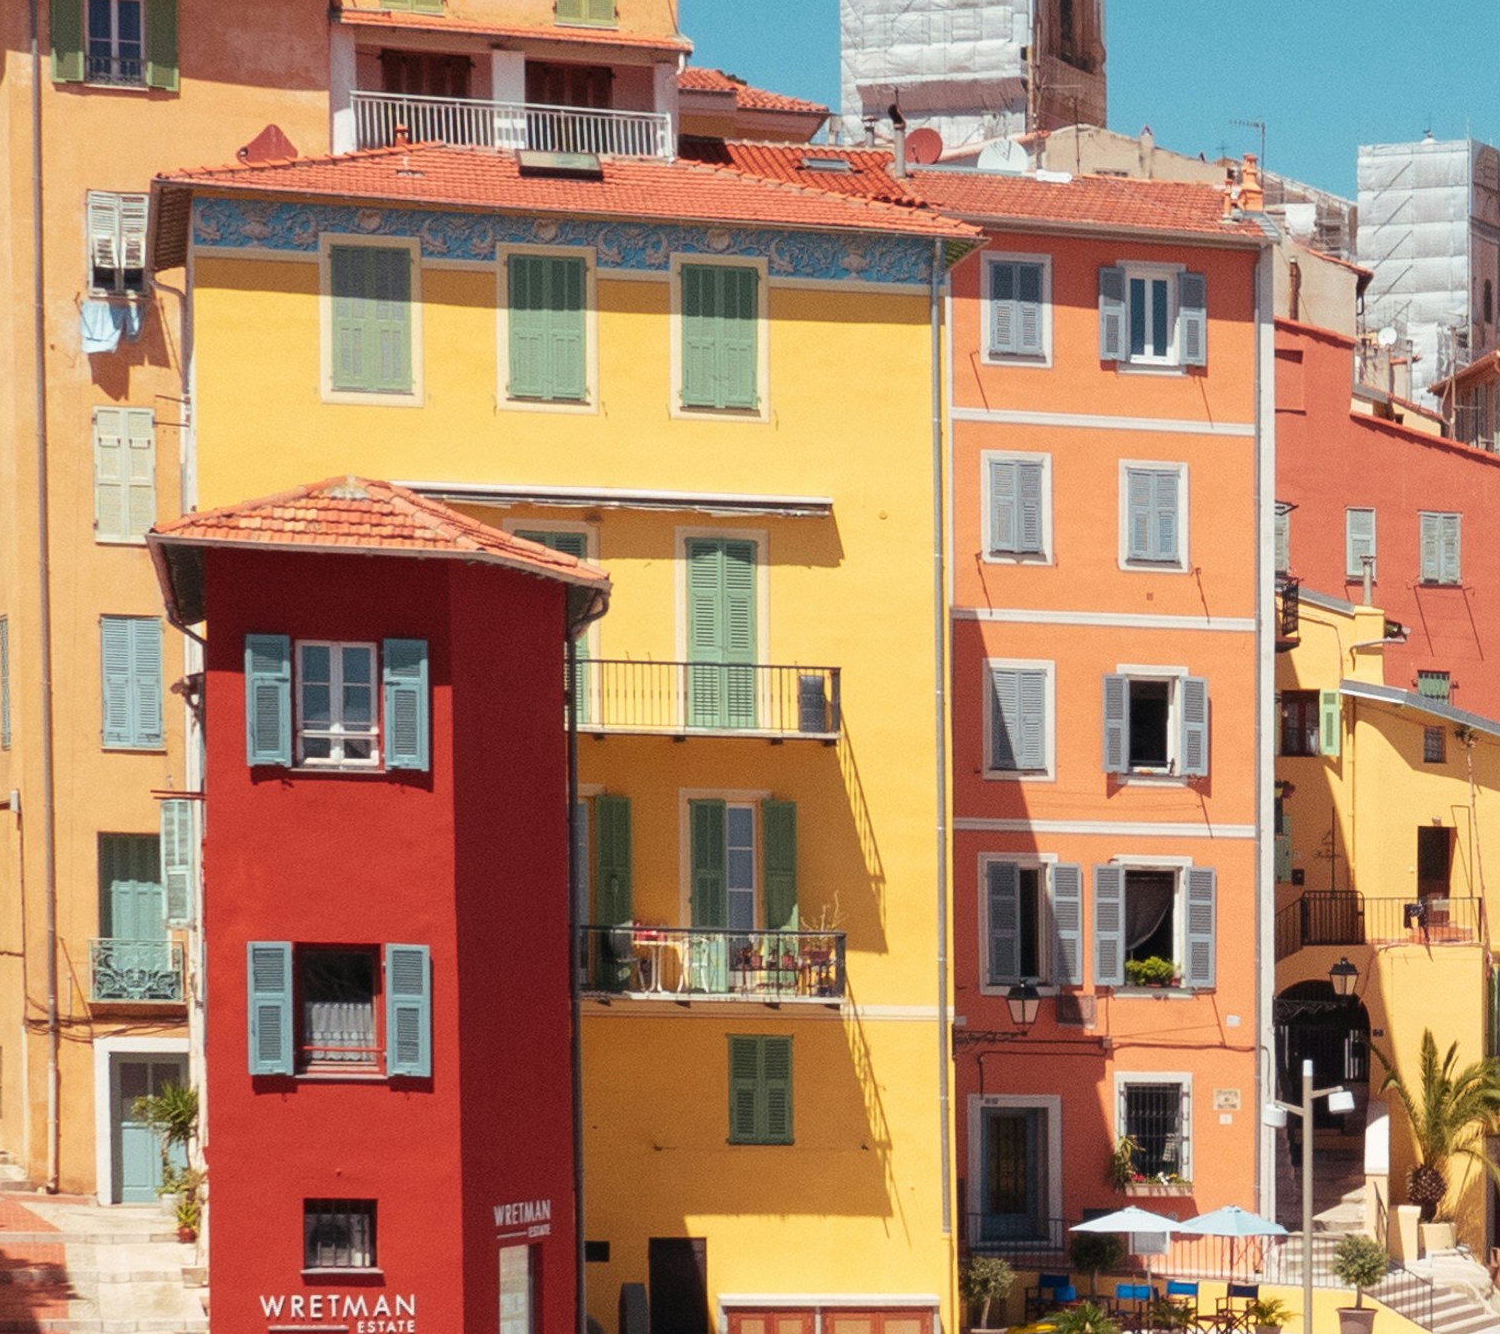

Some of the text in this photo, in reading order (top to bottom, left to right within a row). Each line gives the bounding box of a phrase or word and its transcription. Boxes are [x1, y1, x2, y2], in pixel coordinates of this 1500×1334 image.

[493, 1199, 551, 1227] WRETMAN
[259, 1294, 415, 1318] WRETMAN
[357, 1320, 415, 1334] ESTATE
